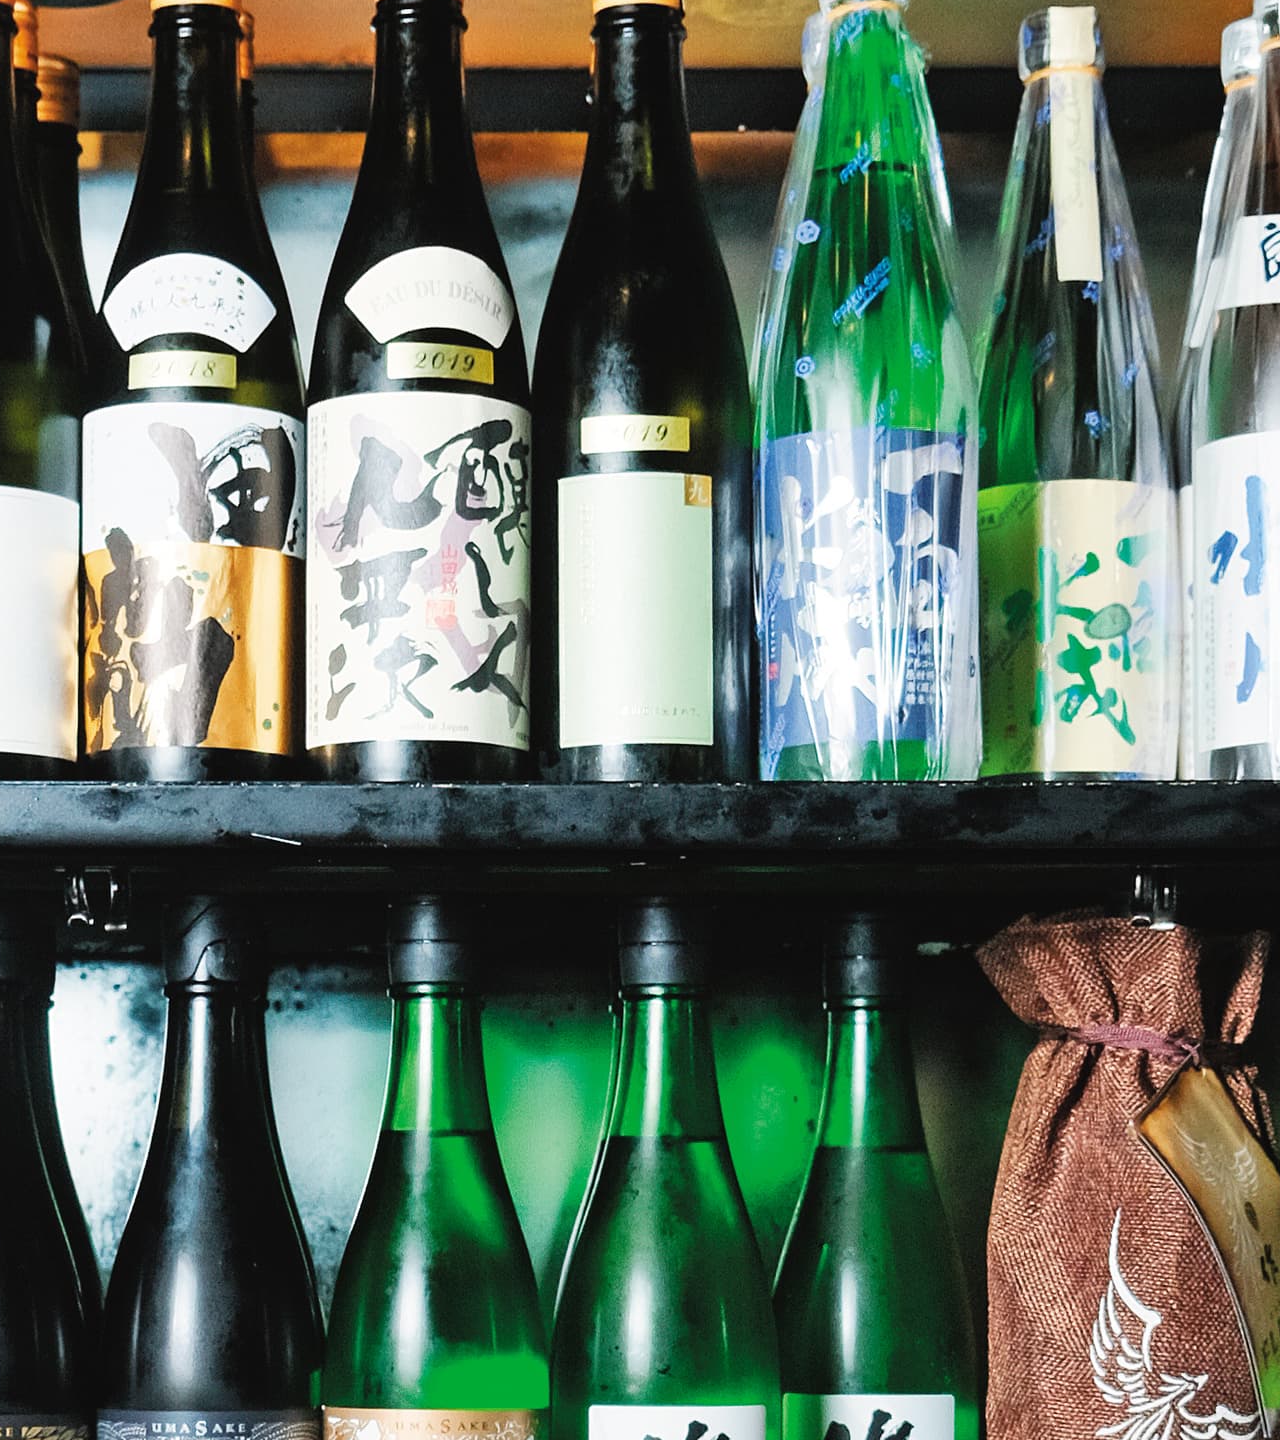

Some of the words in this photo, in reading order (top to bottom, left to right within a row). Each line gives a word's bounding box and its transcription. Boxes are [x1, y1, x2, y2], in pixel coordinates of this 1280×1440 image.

[415, 280, 440, 297] DU
[414, 351, 476, 372] 2019
[688, 480, 707, 503] 九
